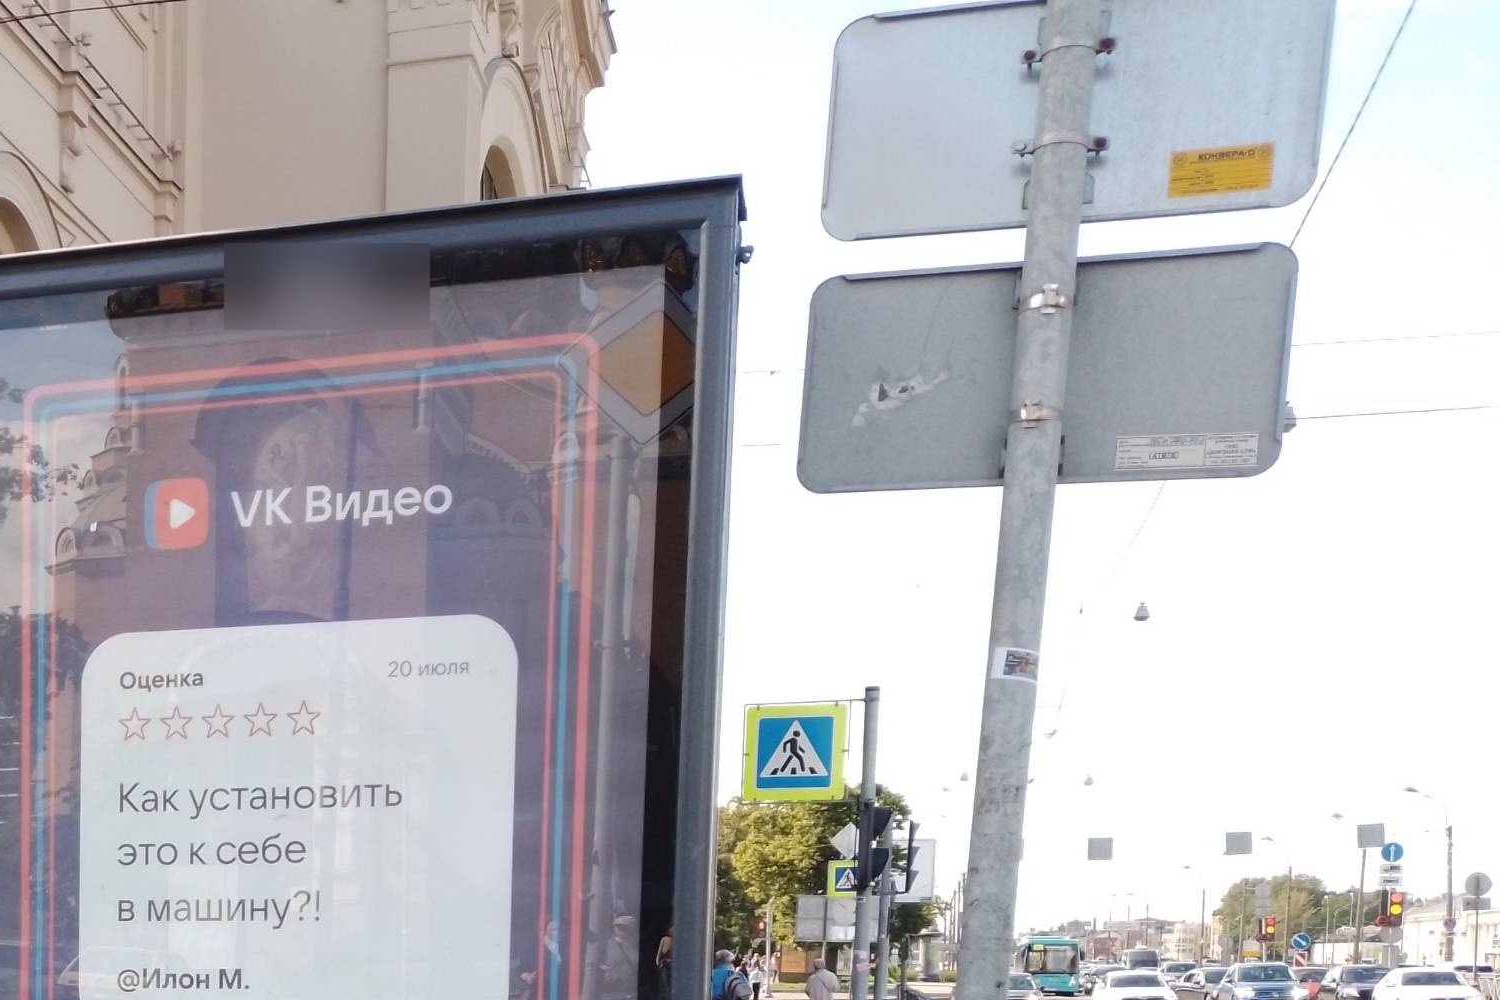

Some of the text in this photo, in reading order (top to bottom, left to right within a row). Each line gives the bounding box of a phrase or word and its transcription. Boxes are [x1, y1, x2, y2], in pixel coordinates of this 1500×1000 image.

[231, 484, 454, 529] VK Видео
[118, 669, 205, 691] Оценка
[387, 659, 471, 679] 20 июля
[118, 781, 404, 820] Как установить
[116, 833, 308, 867] это к себе
[117, 889, 322, 930] в машину?!
[117, 968, 251, 992] @Илон М.
